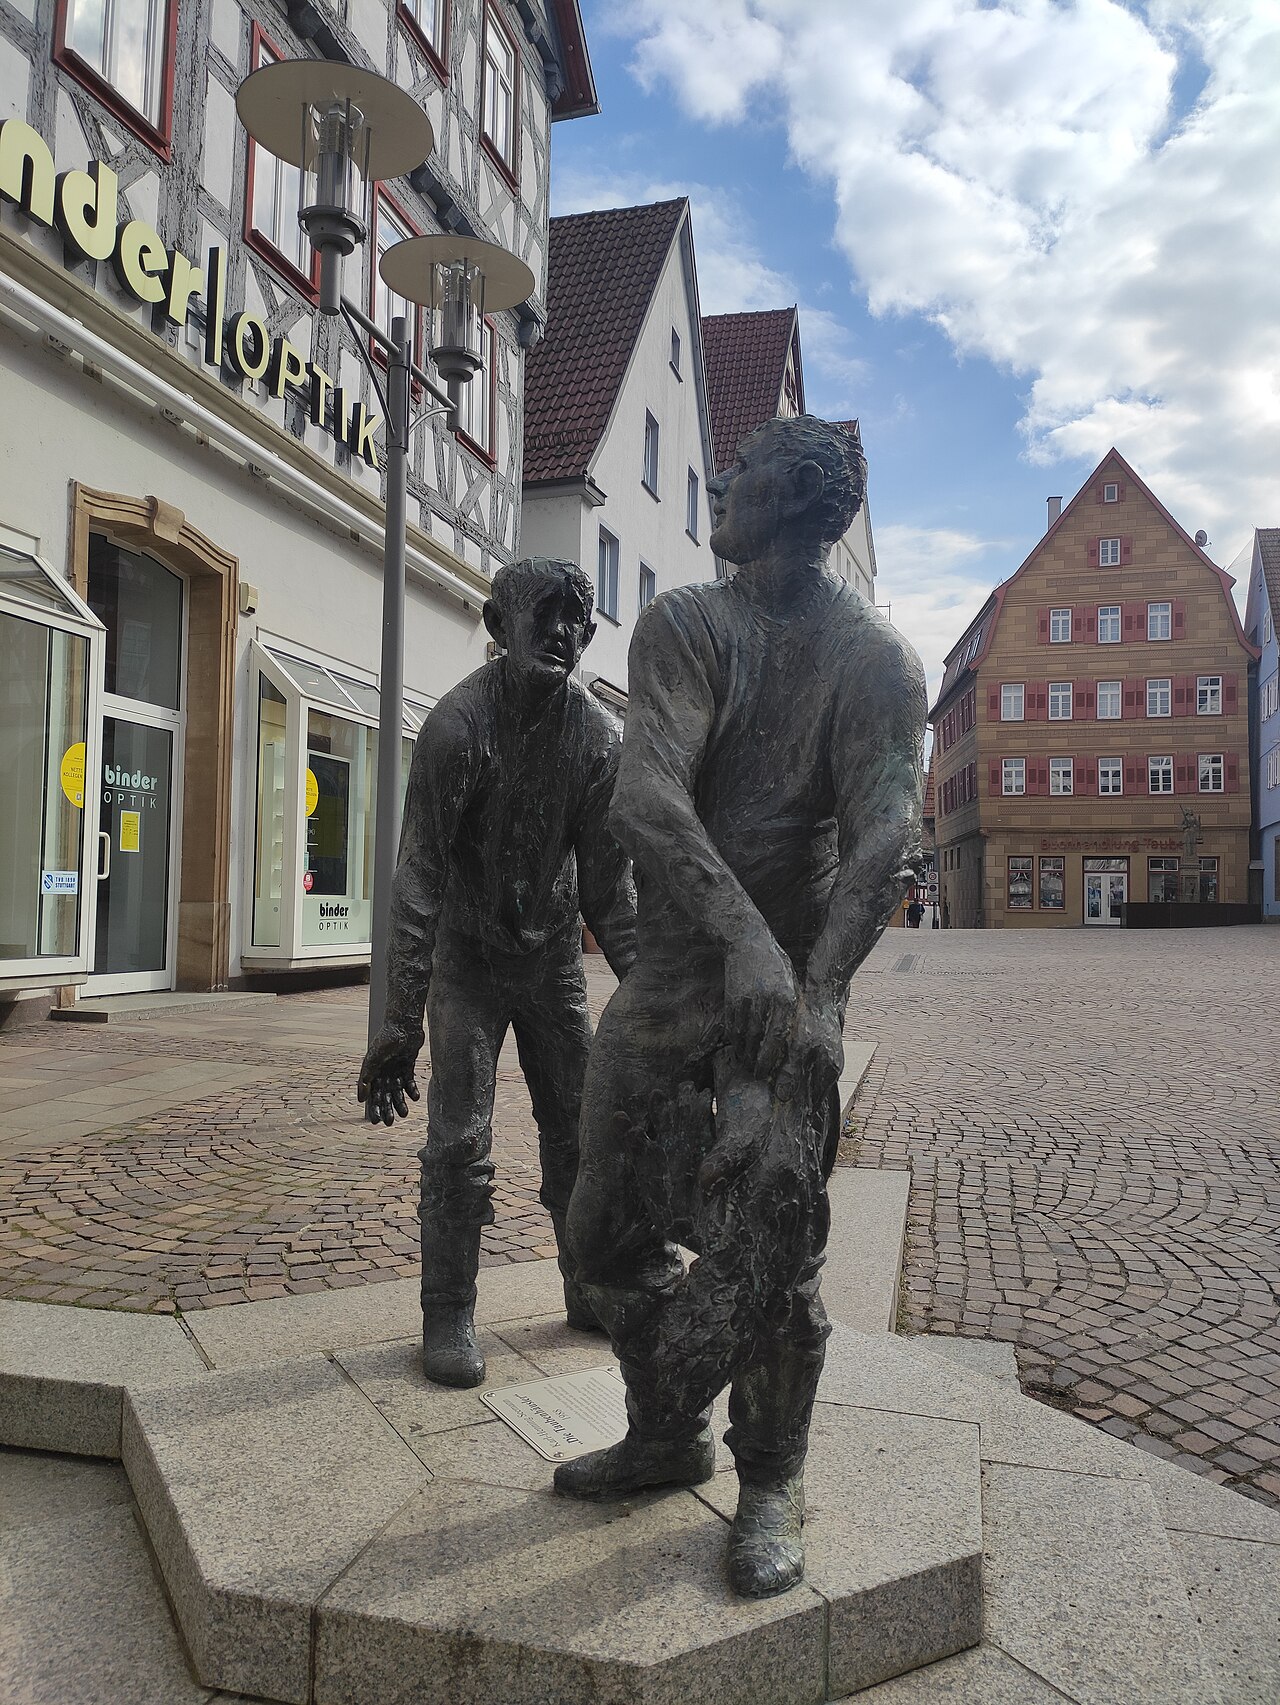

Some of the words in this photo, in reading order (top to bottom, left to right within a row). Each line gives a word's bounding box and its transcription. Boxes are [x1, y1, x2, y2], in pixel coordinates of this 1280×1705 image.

[226, 310, 380, 468] OPTIK
[104, 764, 158, 791] binder
[103, 791, 157, 809] OPTIK
[1040, 836, 1139, 853] Buchhandlung
[319, 902, 349, 917] binder
[318, 921, 349, 931] OPTIK
